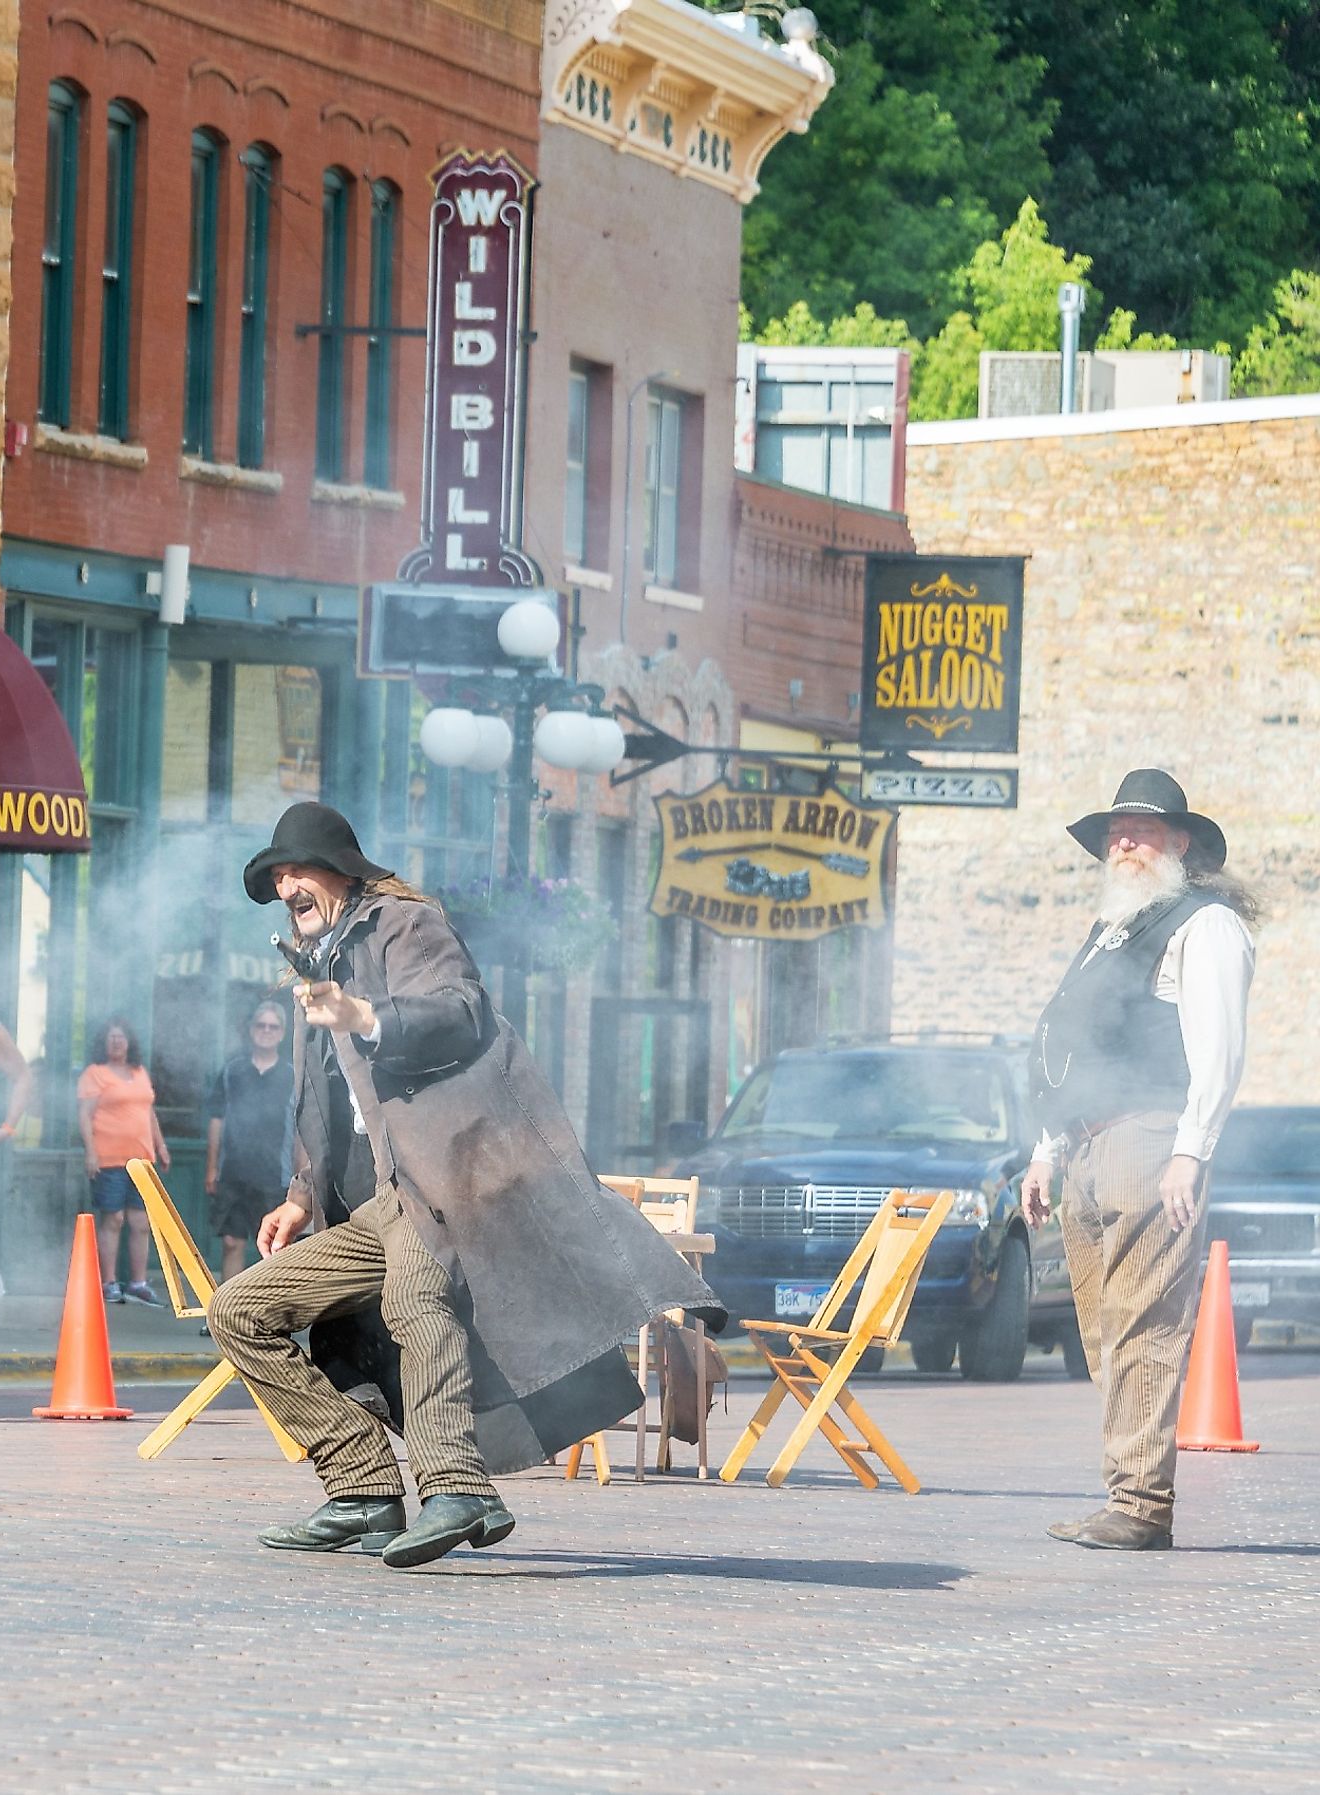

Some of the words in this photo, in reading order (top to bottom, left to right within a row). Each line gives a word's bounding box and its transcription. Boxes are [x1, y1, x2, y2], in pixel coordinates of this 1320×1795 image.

[453, 187, 508, 366] WILD
[446, 394, 494, 570] BILL
[876, 602, 1010, 664] NUGGET
[875, 648, 1006, 710] SALOON
[875, 775, 1006, 798] PIZZA
[669, 798, 776, 841] BROKEN
[782, 800, 880, 850] ARROW
[666, 885, 760, 928] TRADING
[768, 899, 869, 930] COMPANY
